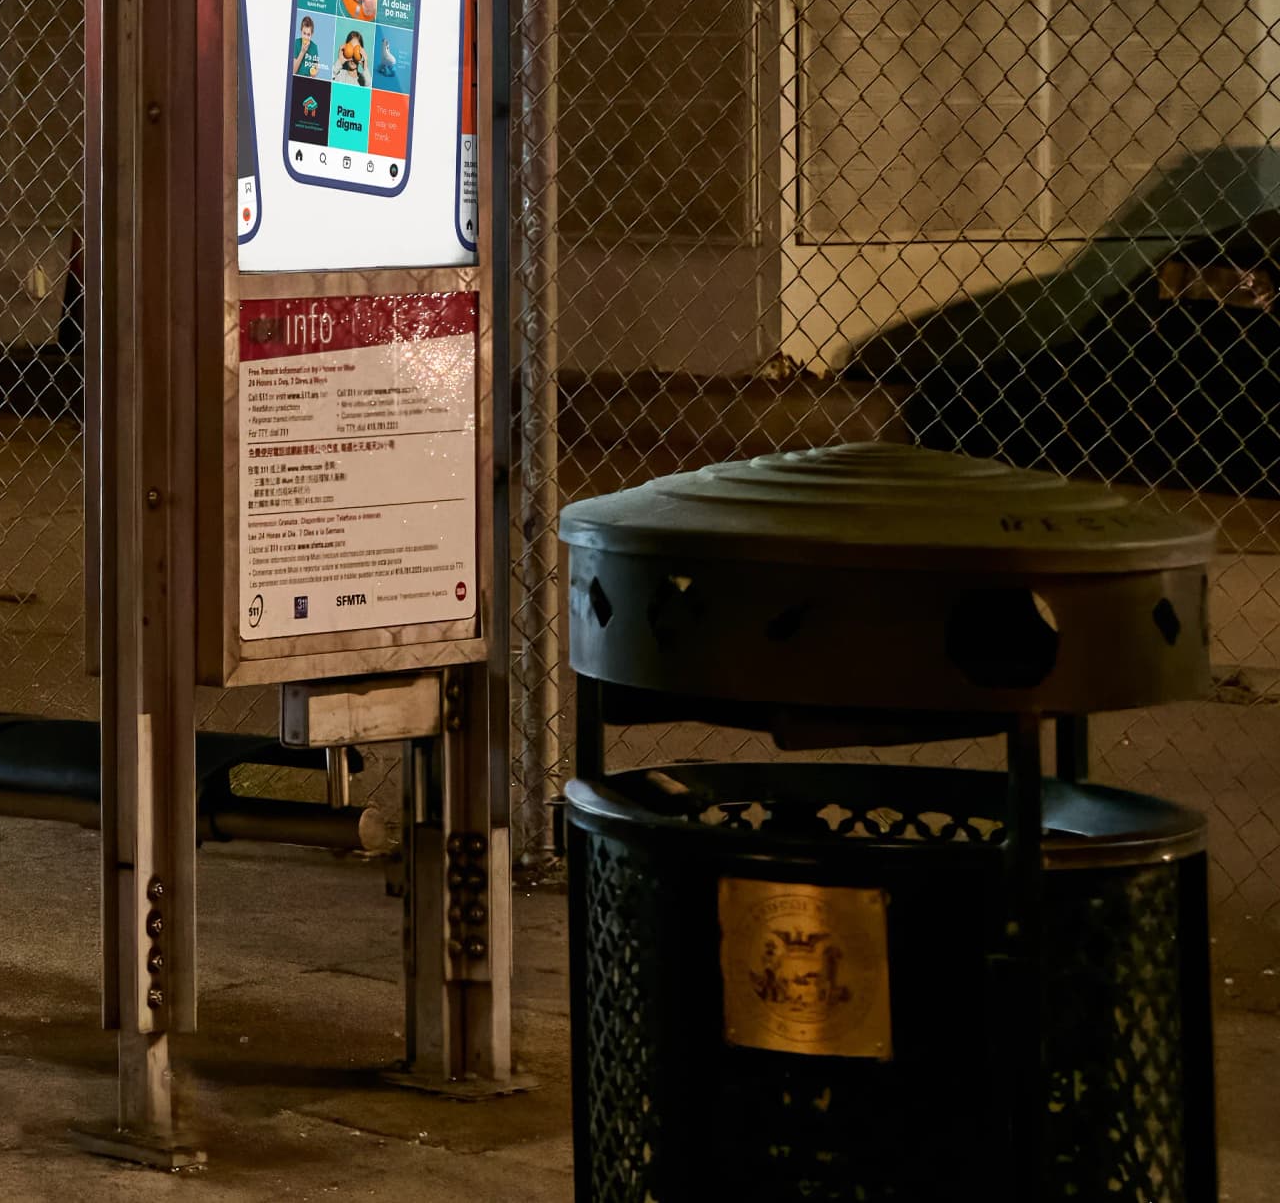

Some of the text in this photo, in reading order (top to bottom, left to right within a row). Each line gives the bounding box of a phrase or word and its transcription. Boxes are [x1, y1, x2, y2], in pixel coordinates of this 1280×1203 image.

[337, 105, 355, 118] Para
[336, 118, 362, 132] digma
[284, 302, 333, 346] info
[336, 594, 367, 607] SFMTA
[248, 607, 259, 617] 511
